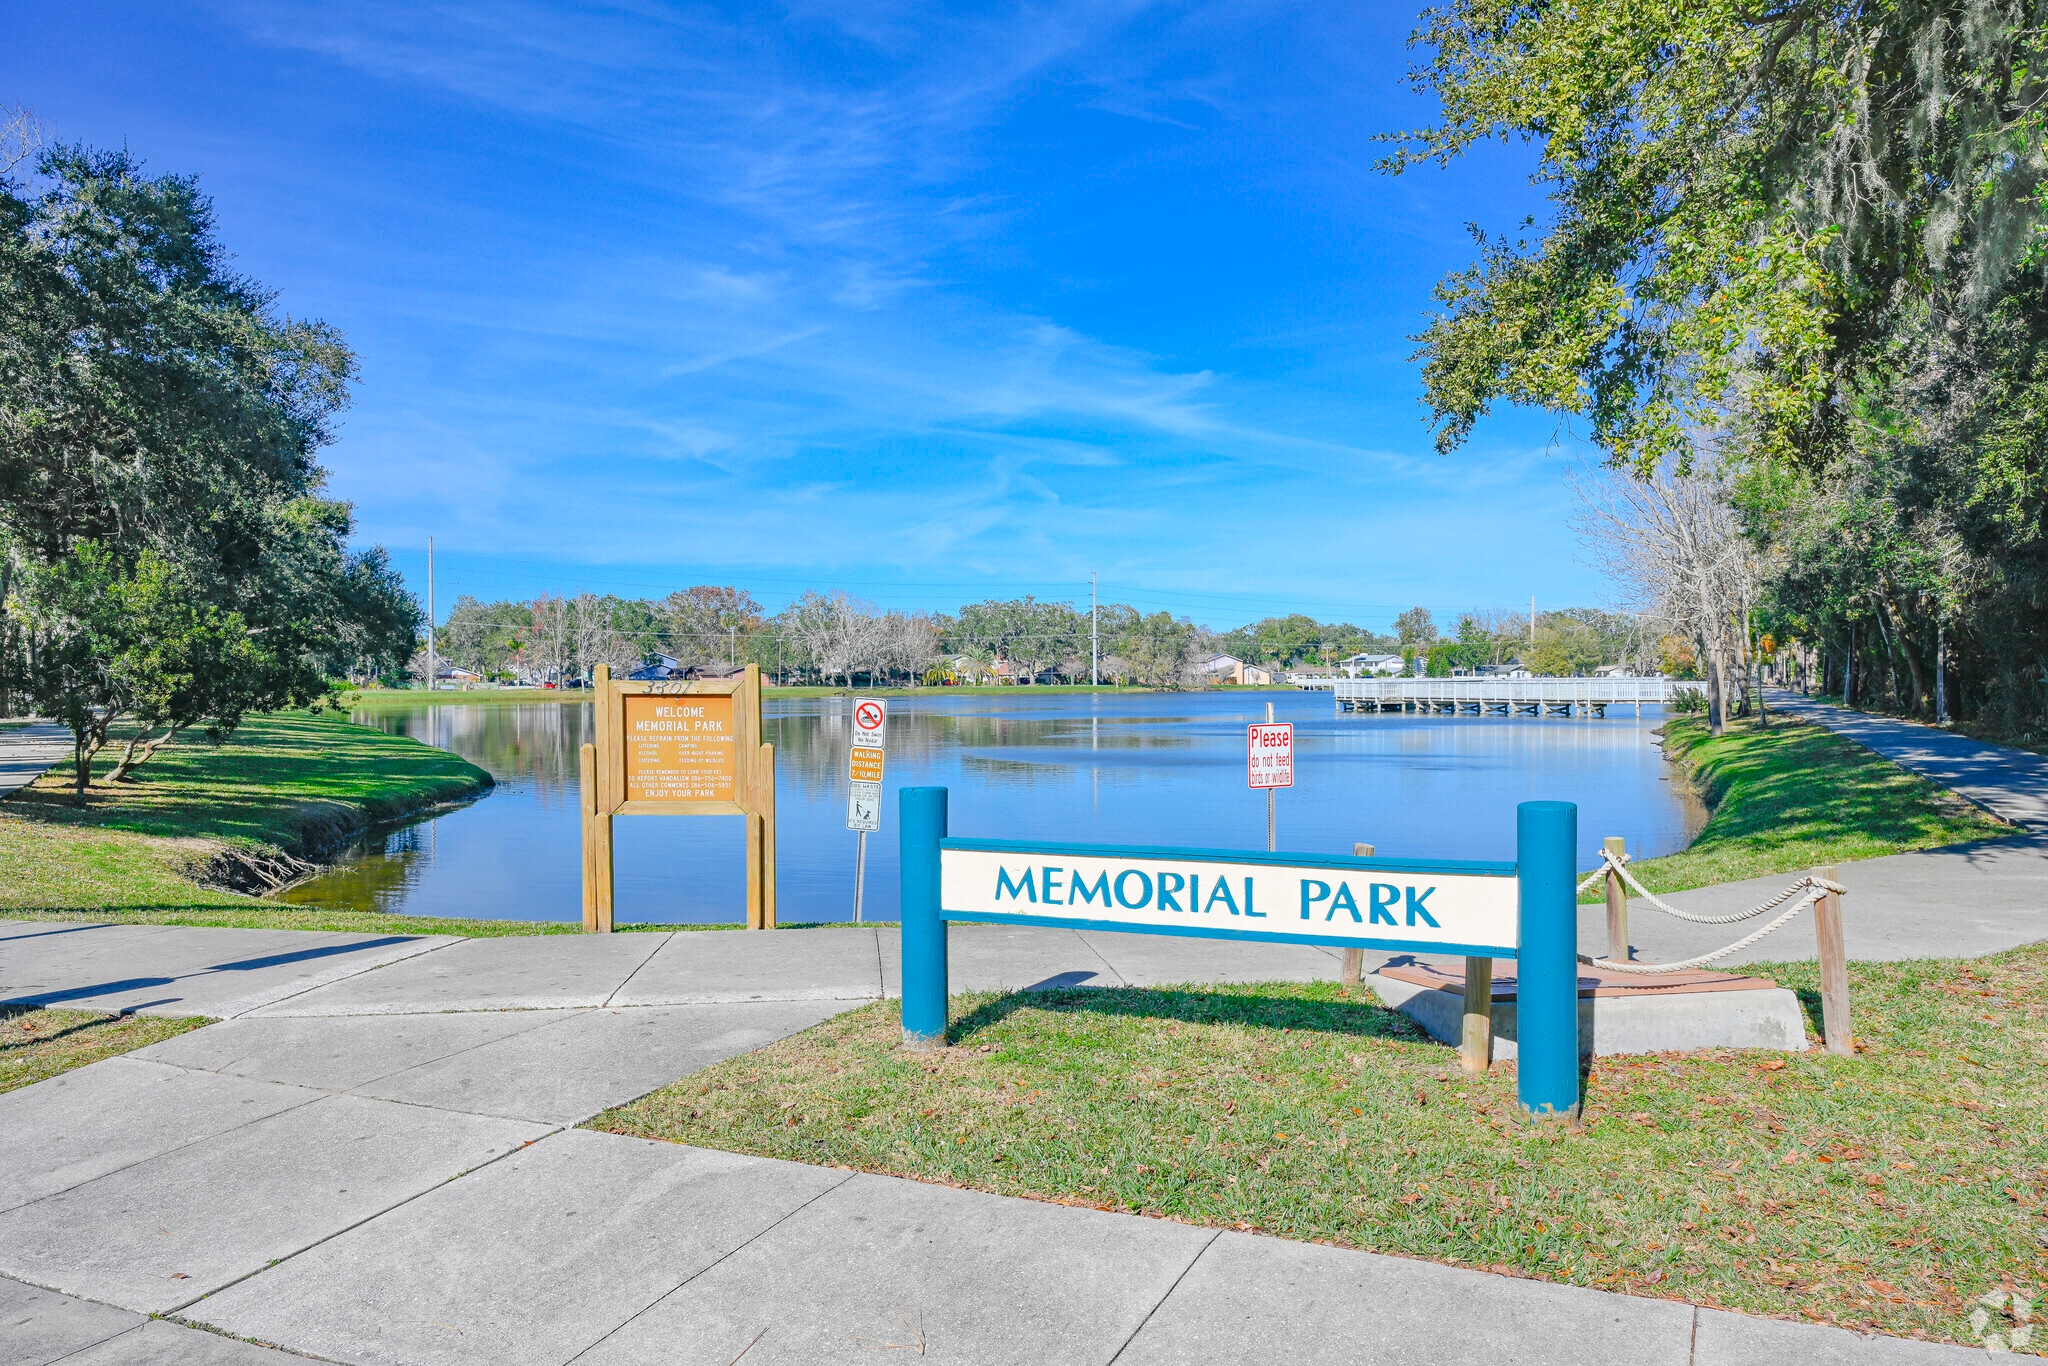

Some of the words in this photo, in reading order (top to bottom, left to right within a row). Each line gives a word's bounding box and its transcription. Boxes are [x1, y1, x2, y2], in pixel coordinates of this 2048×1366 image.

[655, 707, 705, 718] WELCOME
[636, 721, 690, 732] MEMORIAL
[695, 721, 723, 732] PARK
[1251, 728, 1289, 748] Please
[854, 751, 880, 760] WALKING
[1252, 754, 1259, 768] do
[1263, 753, 1273, 767] not
[1276, 752, 1289, 766] feed
[852, 760, 881, 769] DISTANCE
[1252, 770, 1263, 784] birds
[1265, 773, 1270, 784] or
[1272, 769, 1289, 783] wildlife
[994, 865, 1267, 918] MEMORIAL
[1300, 878, 1441, 928] PARK
